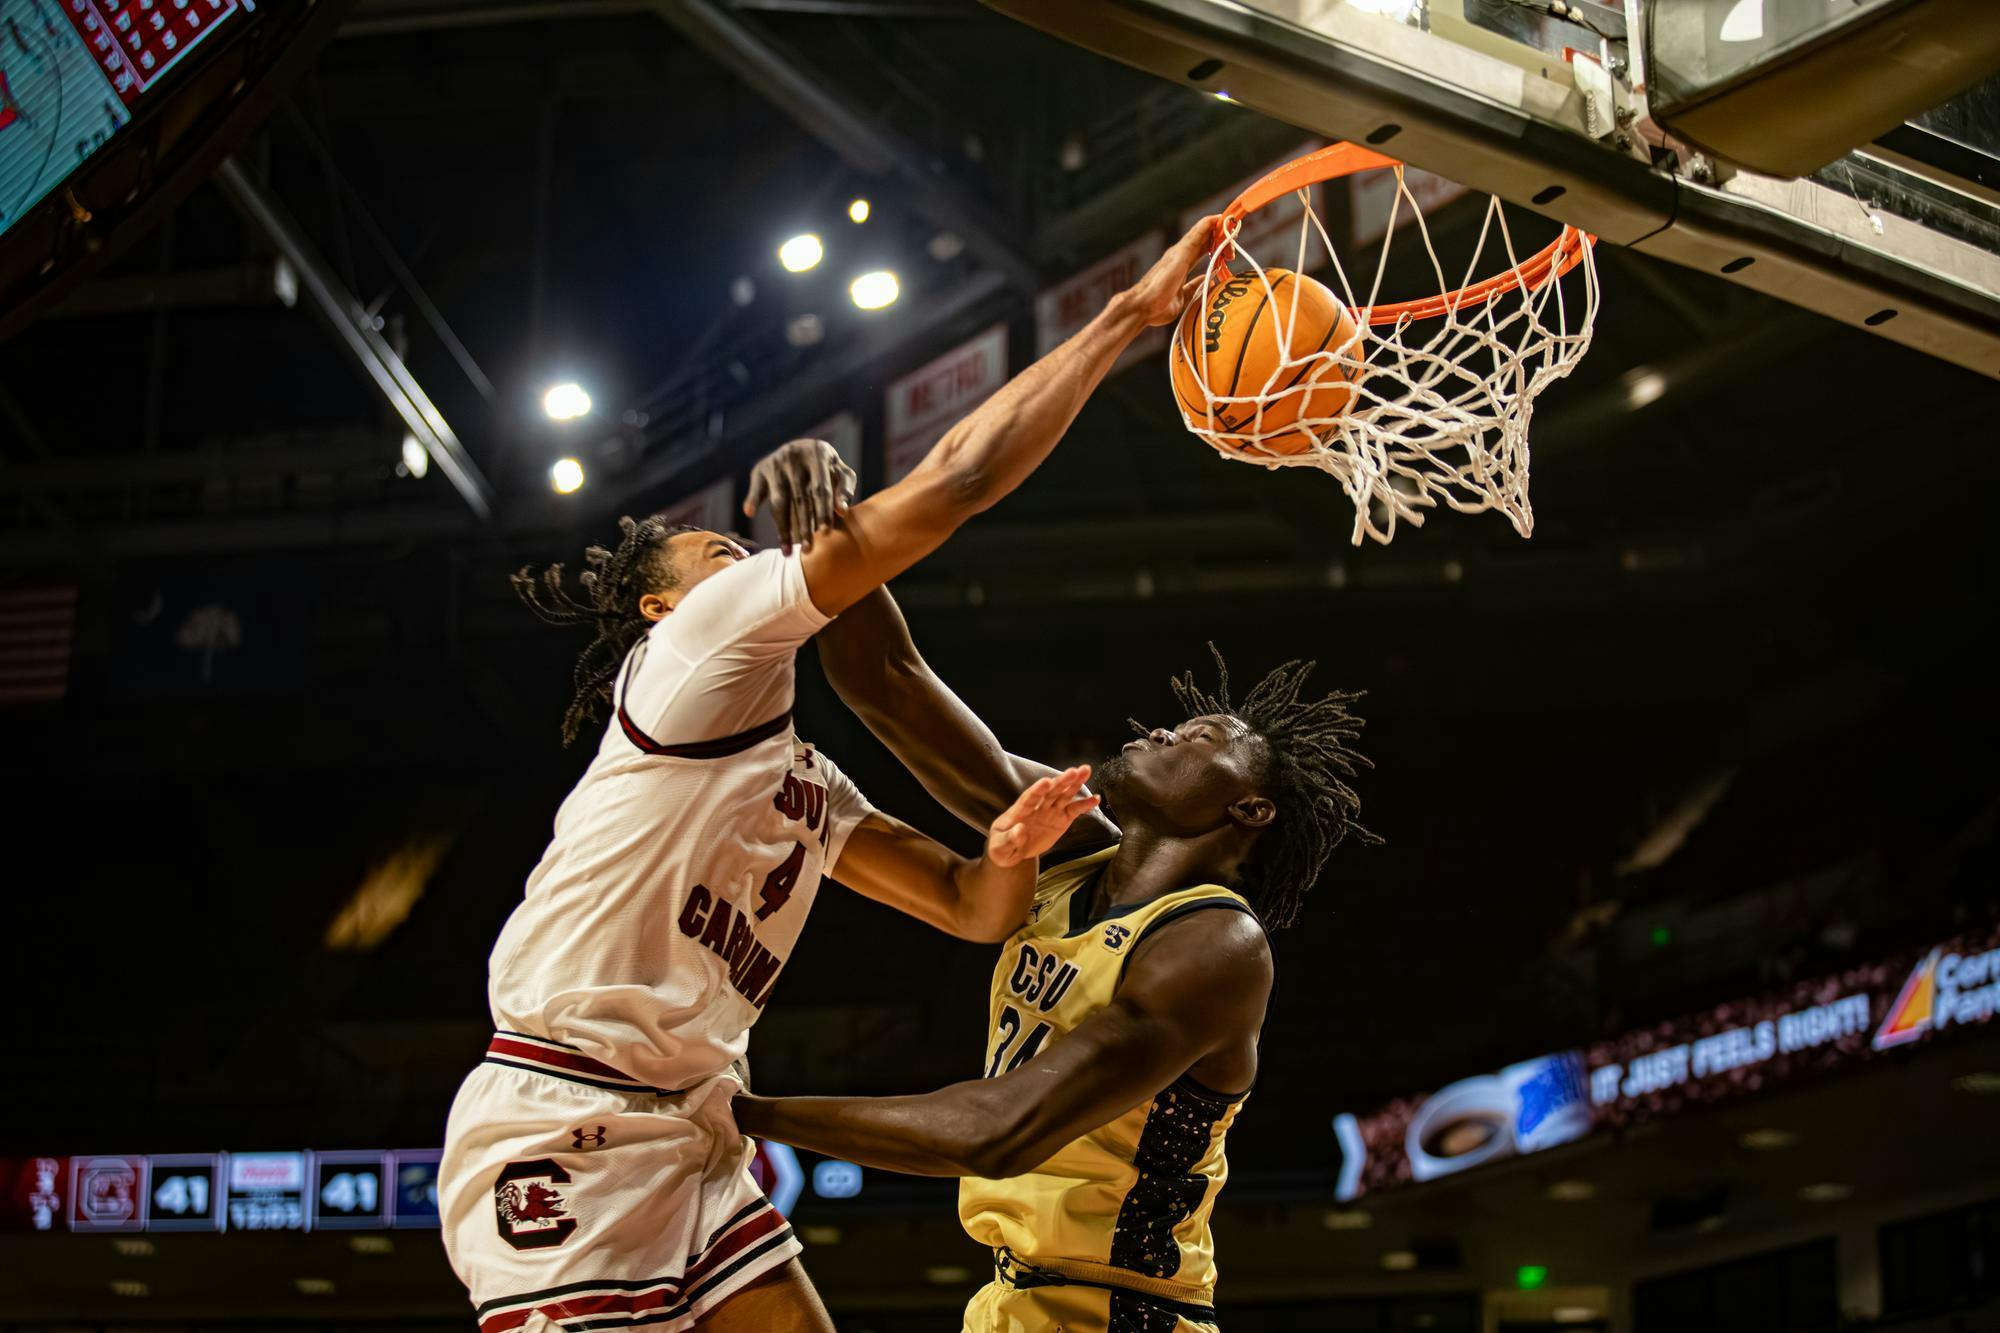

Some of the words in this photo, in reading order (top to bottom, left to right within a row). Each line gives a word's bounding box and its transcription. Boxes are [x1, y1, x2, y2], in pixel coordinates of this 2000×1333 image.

[754, 840, 807, 922] 4
[1010, 943, 1080, 1013] CSU
[1621, 1043, 1690, 1098] JUST
[1691, 1026, 1776, 1079] FEELS
[154, 1175, 210, 1215] 41
[321, 1172, 379, 1213] 41
